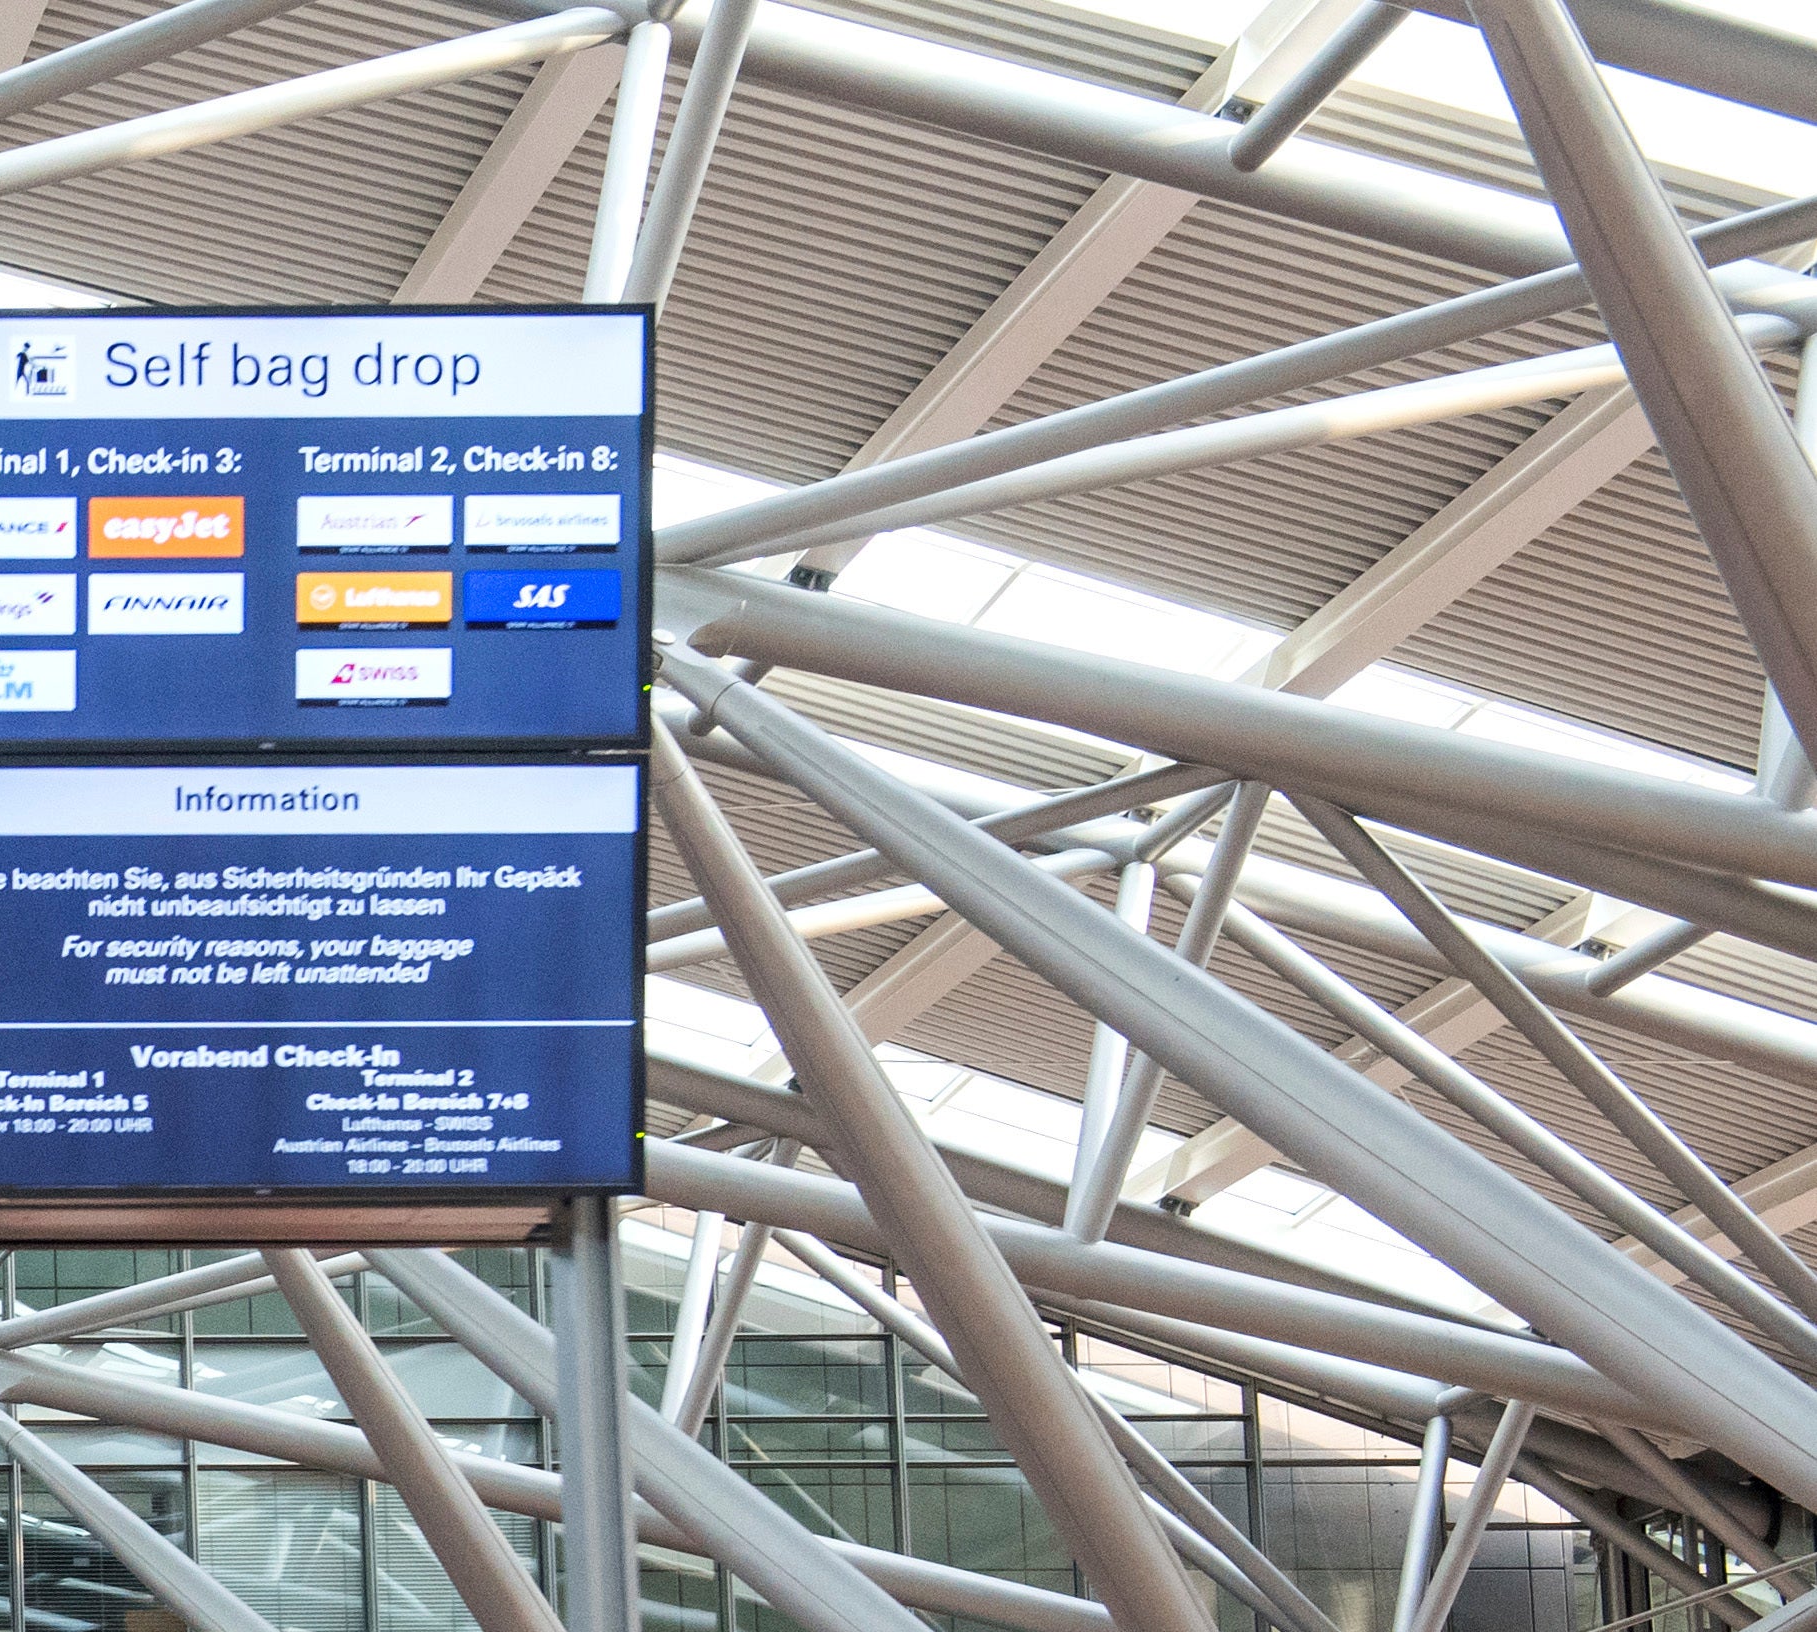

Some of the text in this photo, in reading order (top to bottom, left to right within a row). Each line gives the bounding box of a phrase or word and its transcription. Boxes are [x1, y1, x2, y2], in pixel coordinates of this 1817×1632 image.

[106, 342, 480, 397] Self bag drop
[56, 449, 80, 477] 1,
[88, 447, 208, 474] Check-in
[216, 448, 241, 473] 3:
[299, 446, 617, 475] Terminal 2, Check-in 8:
[103, 510, 230, 544] easyJet
[104, 597, 228, 610] FINNAIR
[513, 584, 570, 608] SAS
[360, 667, 418, 680] SWISS
[177, 786, 358, 811] Information
[12, 868, 118, 890] beachten
[124, 867, 169, 892] Sie,
[175, 872, 218, 889] aus
[223, 867, 451, 893] Sicherheitsgründen
[456, 866, 490, 887] Ihr
[494, 866, 581, 892] Gepäck
[89, 894, 445, 920] nicht unbeaufsichtigt zu lassen
[62, 935, 474, 961] For security reasons, your baggage
[105, 962, 431, 984] must not be left unattended
[131, 1045, 400, 1067] Vorabend Check-In
